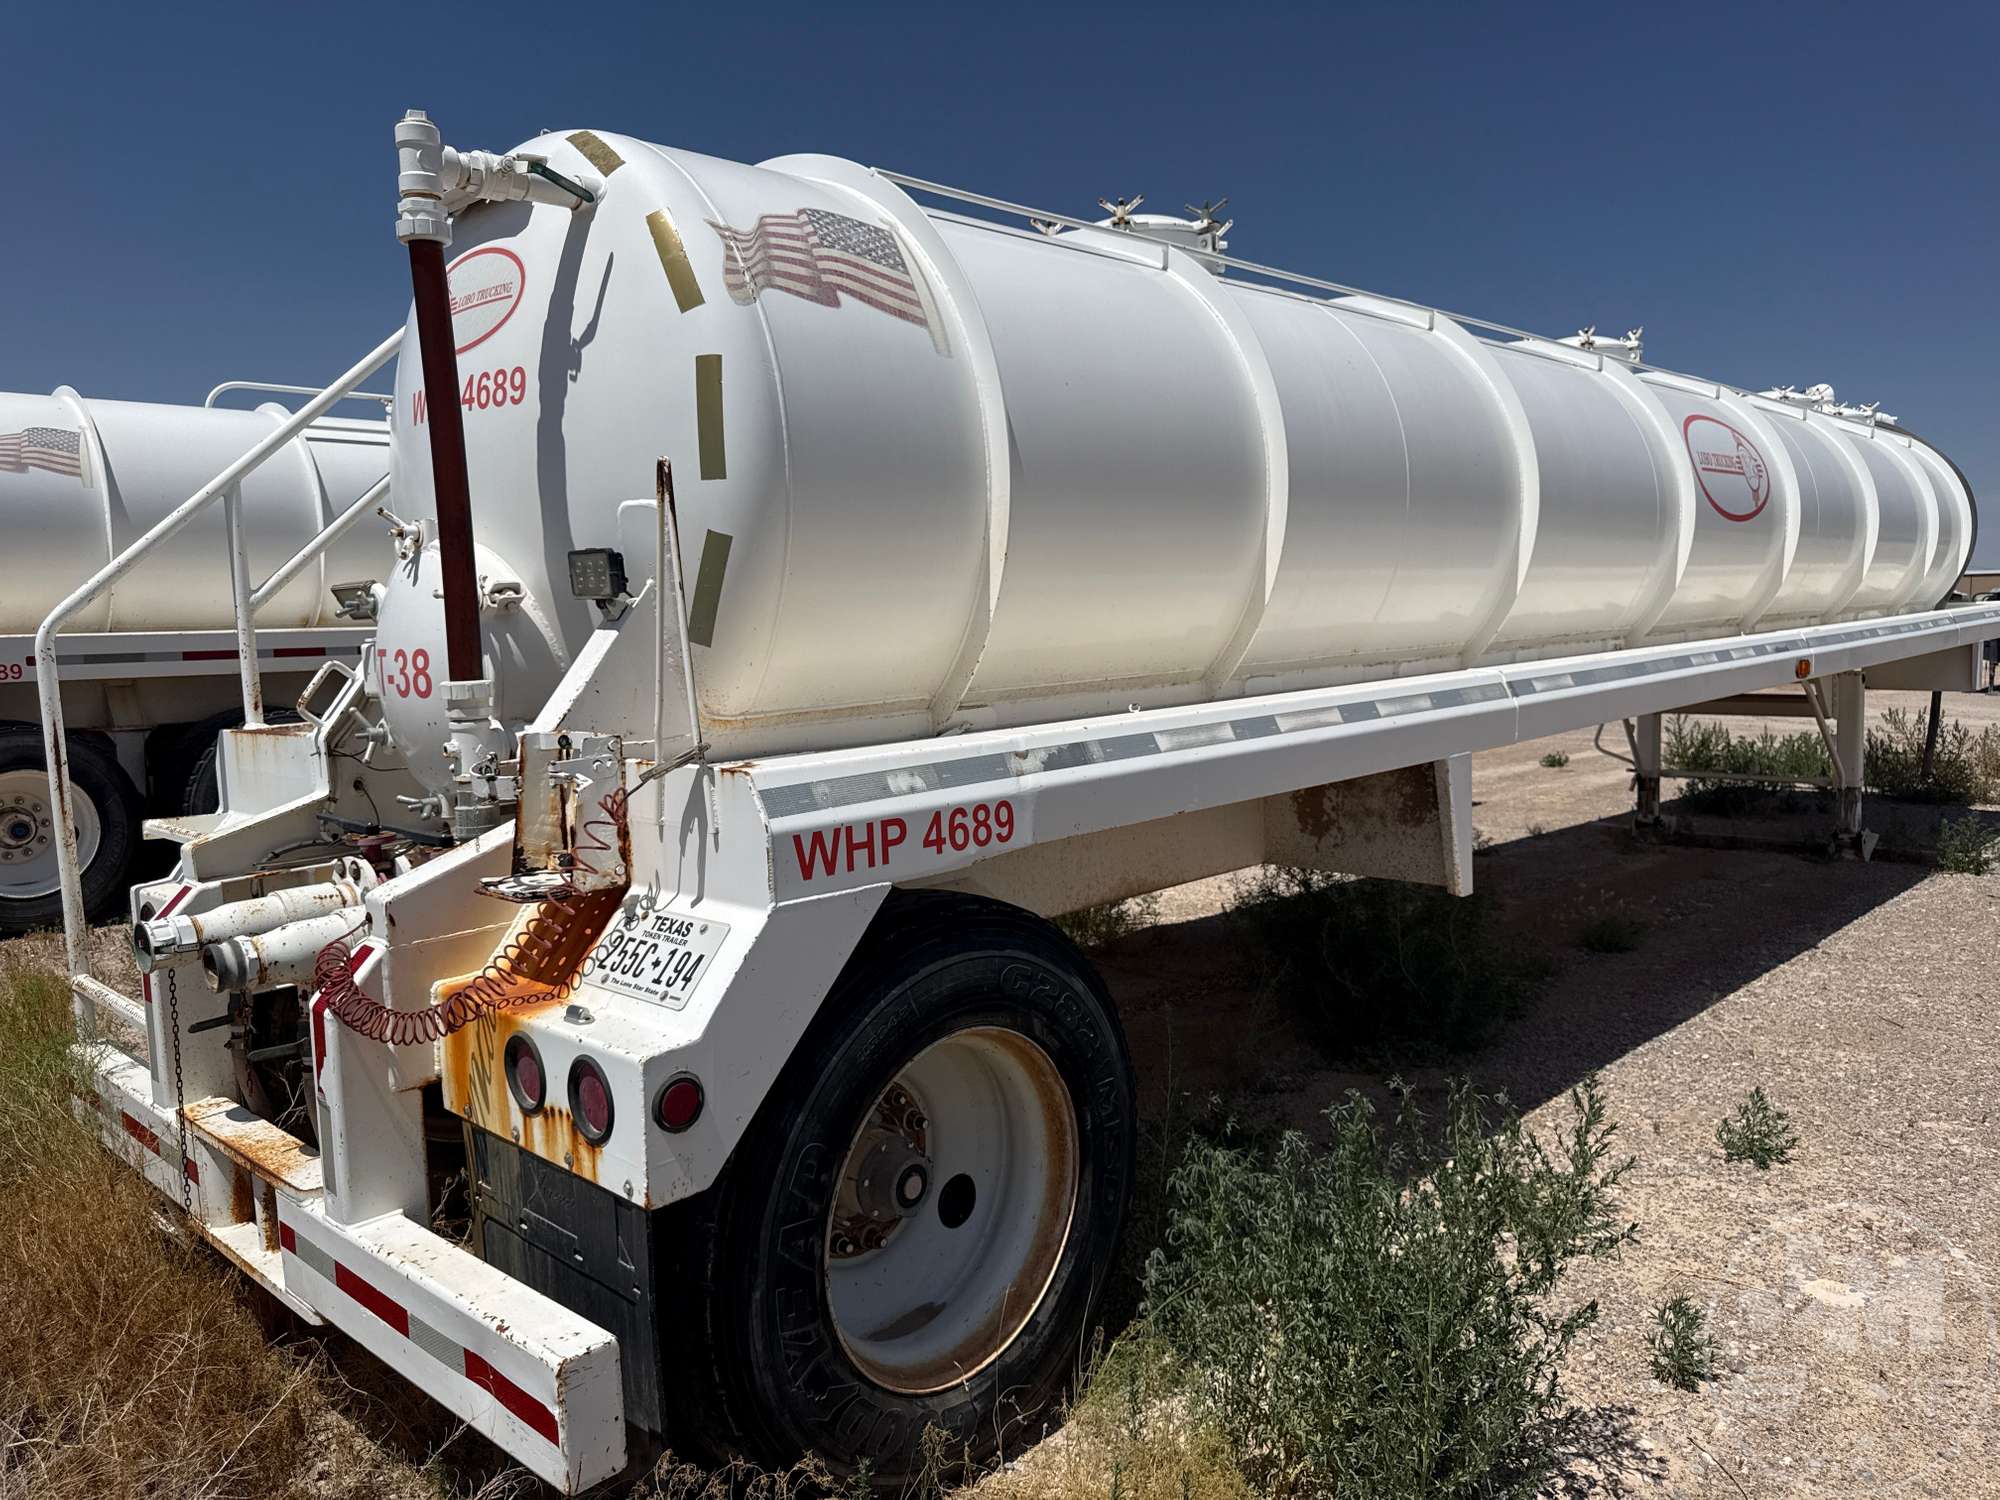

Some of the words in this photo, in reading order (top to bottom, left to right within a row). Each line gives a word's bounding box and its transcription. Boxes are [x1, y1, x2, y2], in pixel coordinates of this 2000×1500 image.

[458, 291, 475, 308] LOBO
[476, 281, 513, 301] TRUCKING
[462, 366, 526, 411] 4689
[377, 648, 432, 699] T-38
[793, 817, 907, 881] WHP
[923, 800, 1014, 855] 4689
[642, 930, 661, 941] TOKEN
[661, 934, 688, 947] TRAILER
[651, 915, 694, 938] TEXAS
[620, 980, 633, 988] Lone
[632, 983, 645, 991] Star
[644, 986, 659, 995] State
